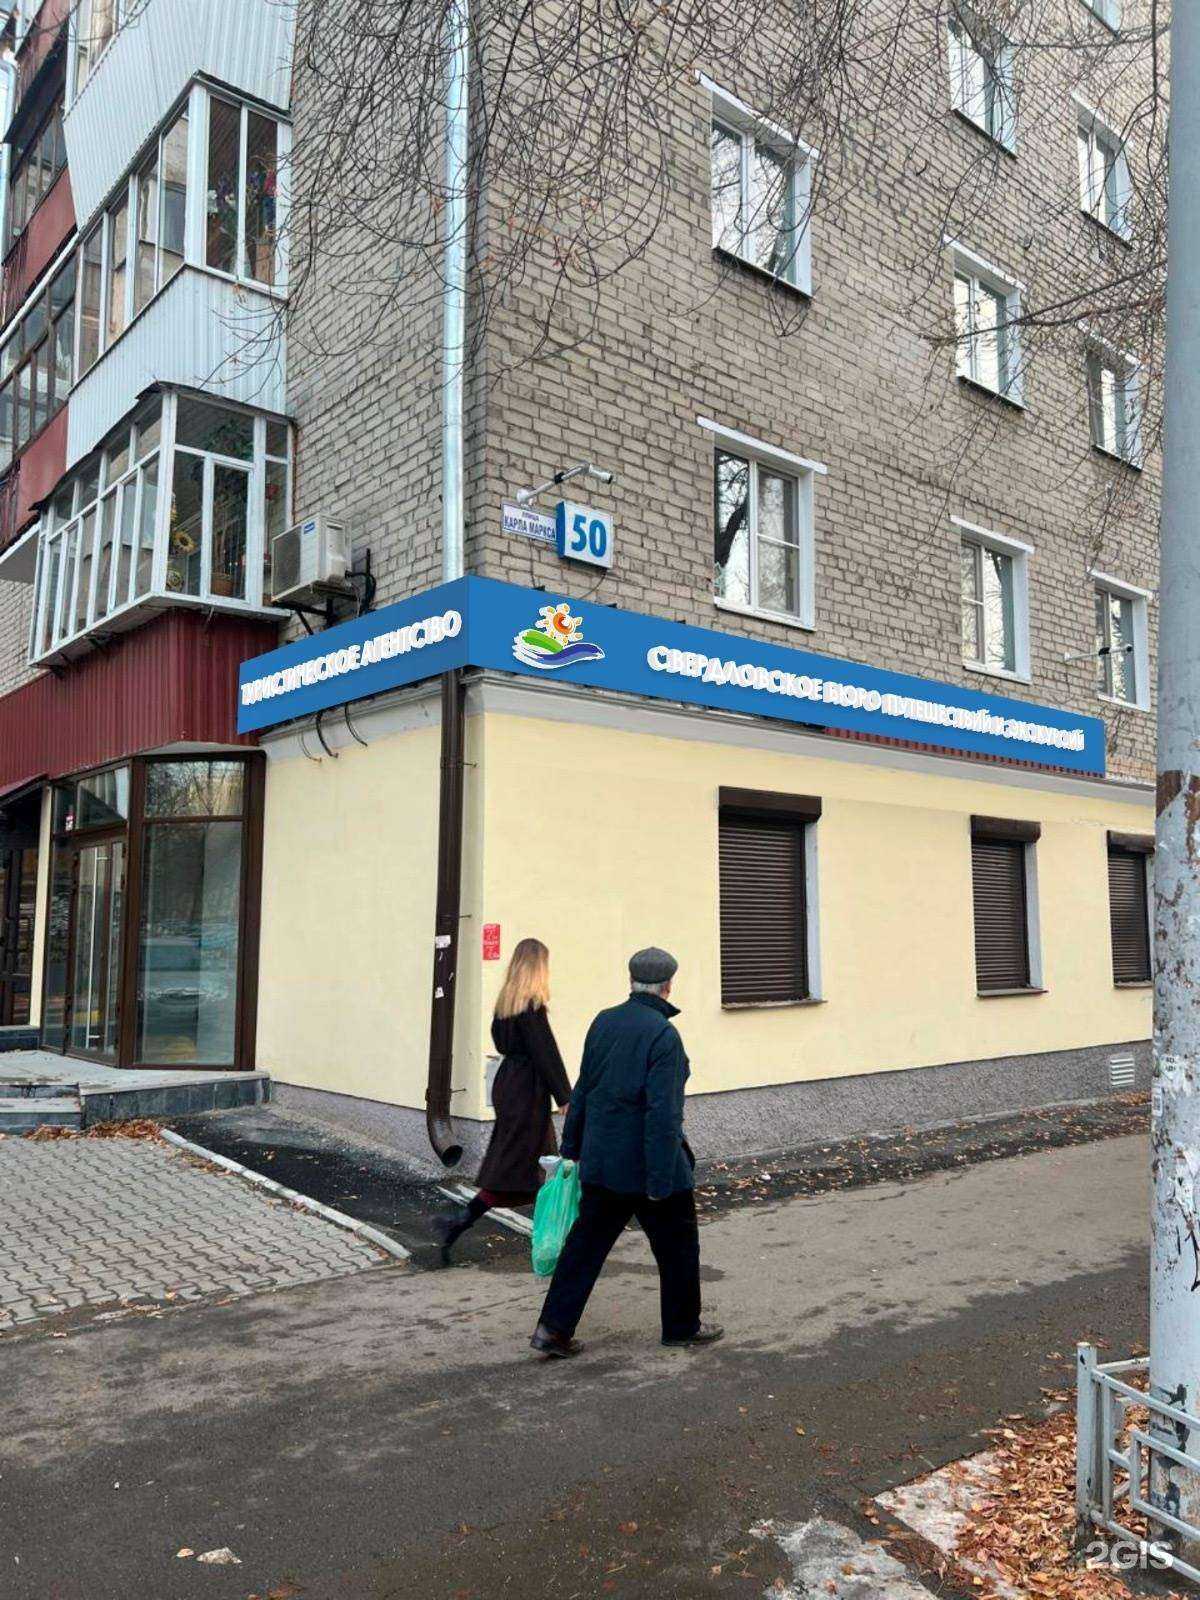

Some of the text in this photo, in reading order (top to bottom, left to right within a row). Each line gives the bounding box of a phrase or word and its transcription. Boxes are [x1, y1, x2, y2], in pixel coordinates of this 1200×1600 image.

[504, 515, 556, 539] КАРЛА МАРКСА
[571, 514, 607, 557] 50
[240, 610, 463, 705] ТУРИСТИЧЕСКОЕ АГЕНТСТВО
[646, 645, 823, 701] СВЕРДЛОВСКОЕ
[822, 681, 882, 712] БЮРО
[881, 693, 991, 733] ПУТЕШЕСТВИЙ
[1003, 718, 1085, 751] ЭКСКУРСИЙ
